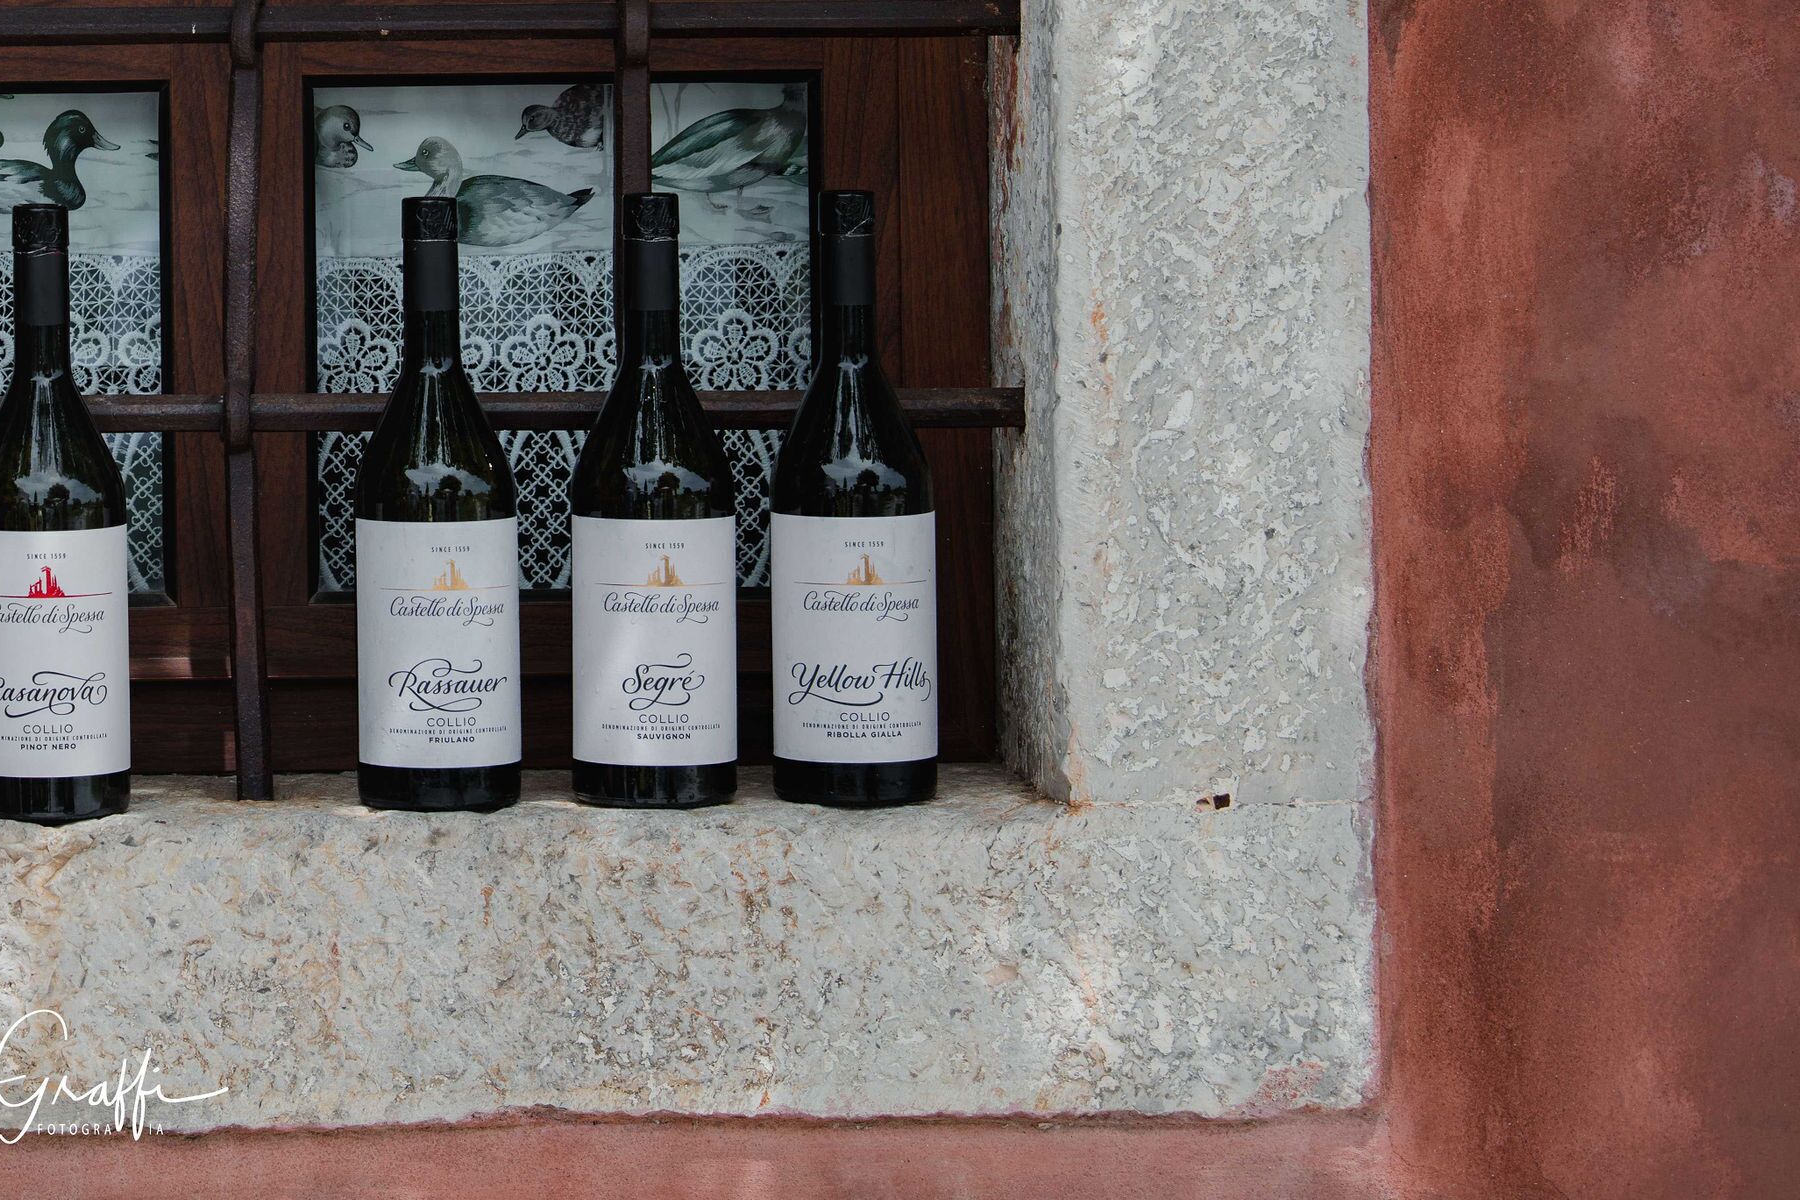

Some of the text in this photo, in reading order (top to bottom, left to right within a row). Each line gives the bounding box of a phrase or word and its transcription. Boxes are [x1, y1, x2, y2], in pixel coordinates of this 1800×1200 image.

[390, 596, 505, 626] Castello di Spessa
[604, 592, 720, 624] Castello di Spessa
[803, 590, 919, 621] Castello di Spessa
[41, 605, 59, 624] di
[58, 603, 105, 634] Spessa
[388, 658, 508, 712] Rassauer
[622, 653, 705, 711] Segré
[788, 656, 931, 706] Yellow Hills
[427, 717, 477, 727] COLLIO
[639, 713, 689, 724] COLLIO
[839, 711, 890, 722] COLLIO
[23, 724, 74, 734] COLLIO
[389, 727, 436, 735] DENOMINAZIONE
[448, 727, 473, 735] ORIGINE
[602, 723, 649, 731] DENOMINAZIONE
[871, 730, 902, 738] GIALLA
[20, 743, 49, 751] PINOT
